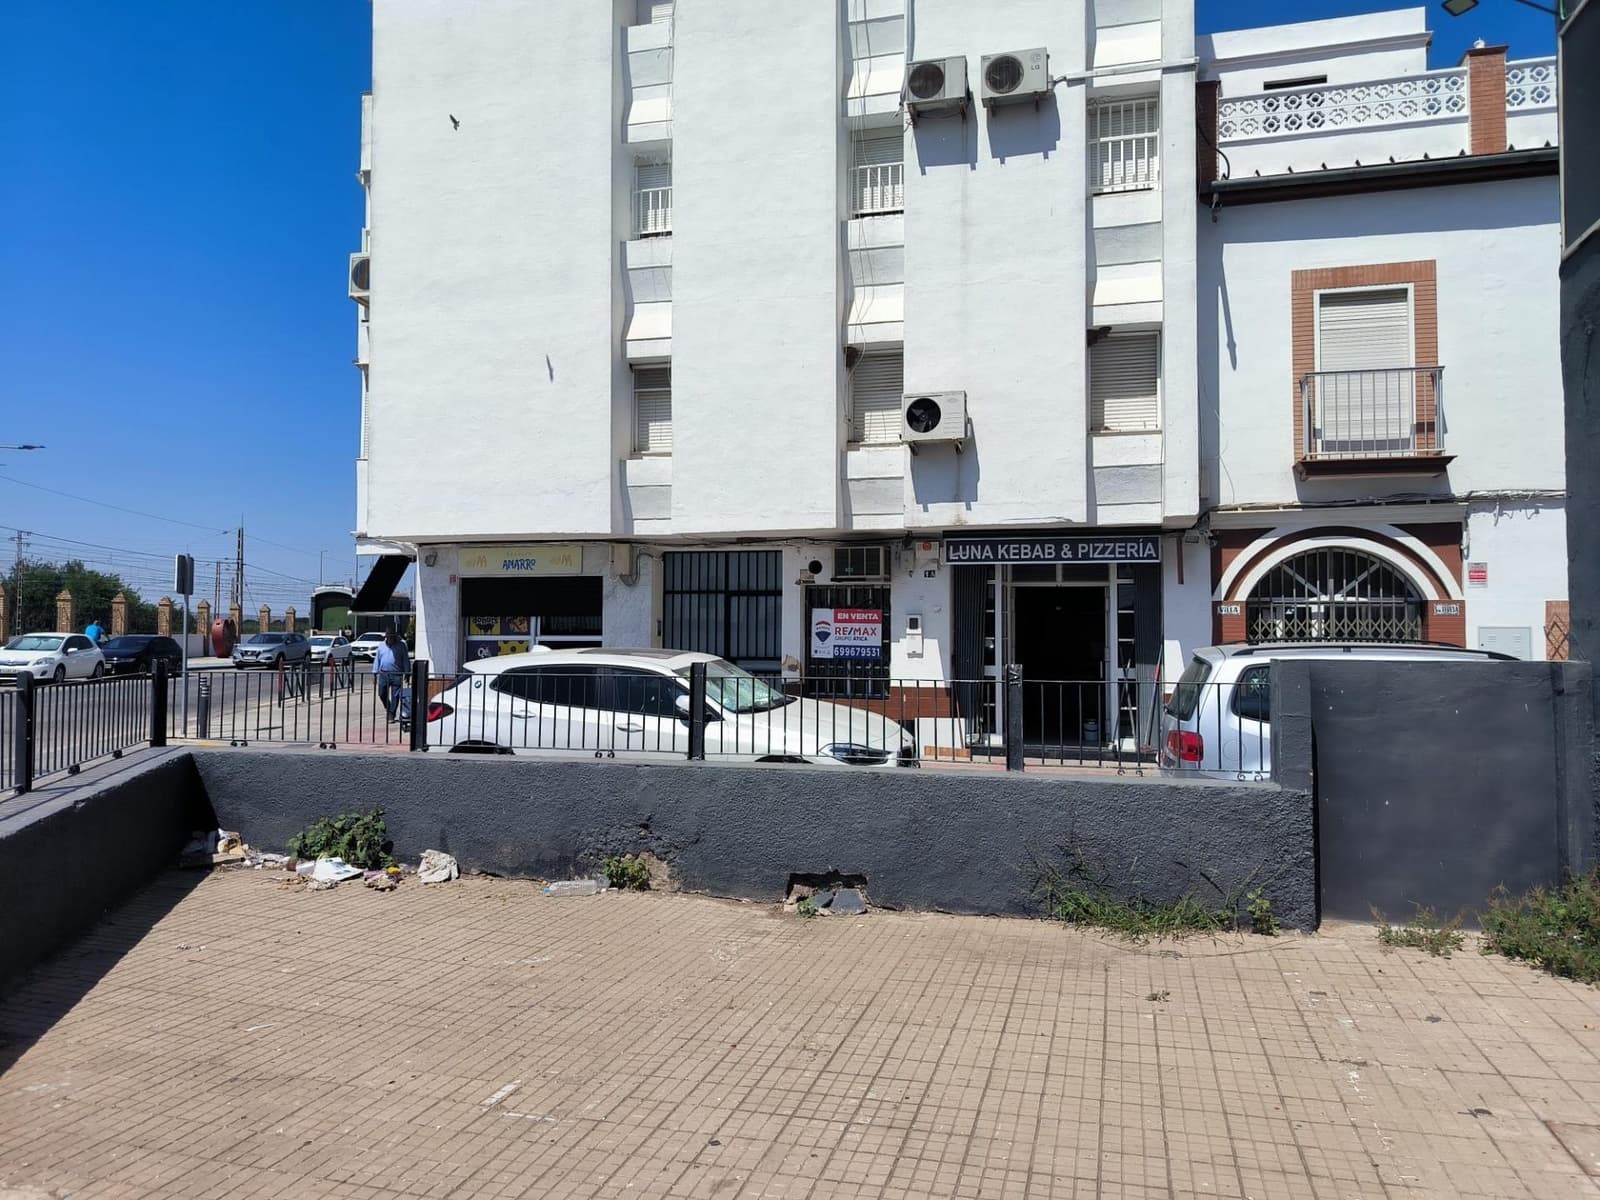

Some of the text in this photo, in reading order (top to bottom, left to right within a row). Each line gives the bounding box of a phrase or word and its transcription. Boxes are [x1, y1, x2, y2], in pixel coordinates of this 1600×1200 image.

[949, 539, 1157, 560] LUNA KEBAB & PIZZERÍA
[502, 558, 537, 570] AMARRO
[834, 626, 877, 636] RE/MAX
[834, 646, 880, 656] 699679531
